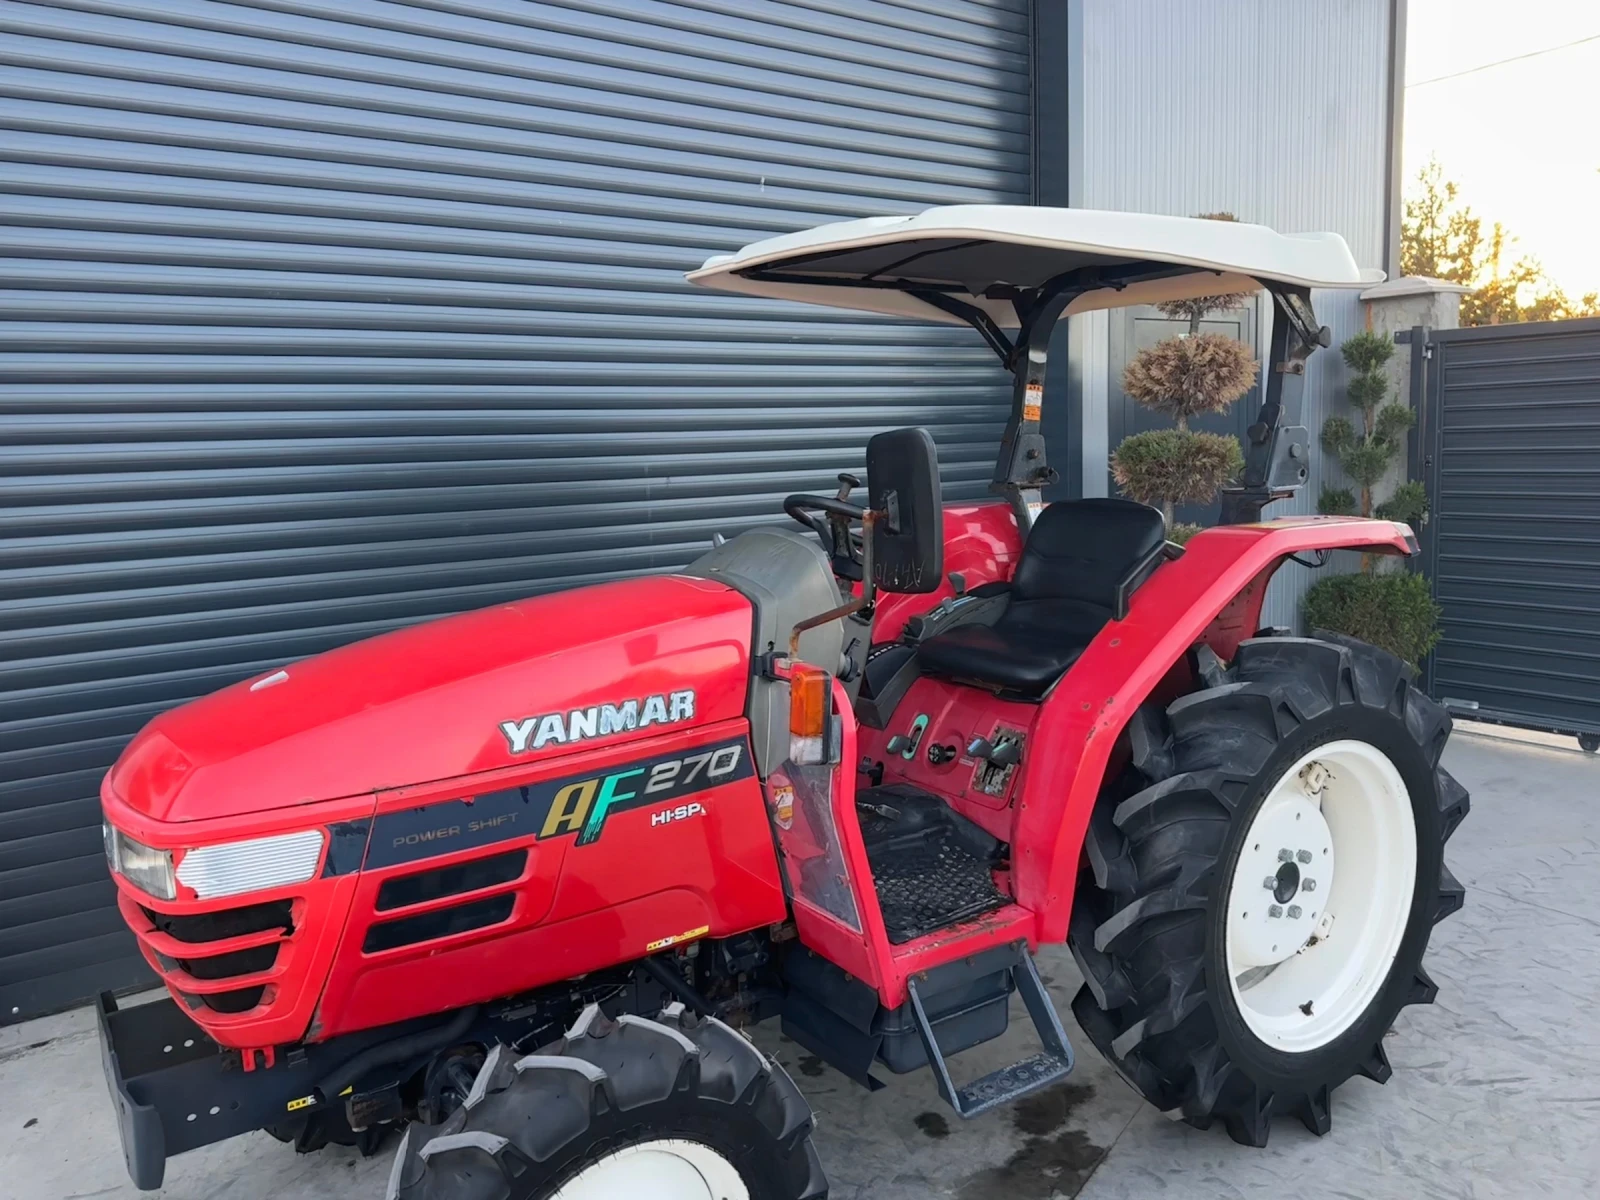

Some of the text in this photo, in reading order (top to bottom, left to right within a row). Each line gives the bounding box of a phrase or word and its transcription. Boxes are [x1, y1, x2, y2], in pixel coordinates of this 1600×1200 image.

[501, 690, 695, 752] YANMAR
[539, 745, 743, 844] AF 270
[392, 812, 519, 848] POWER SHIFT
